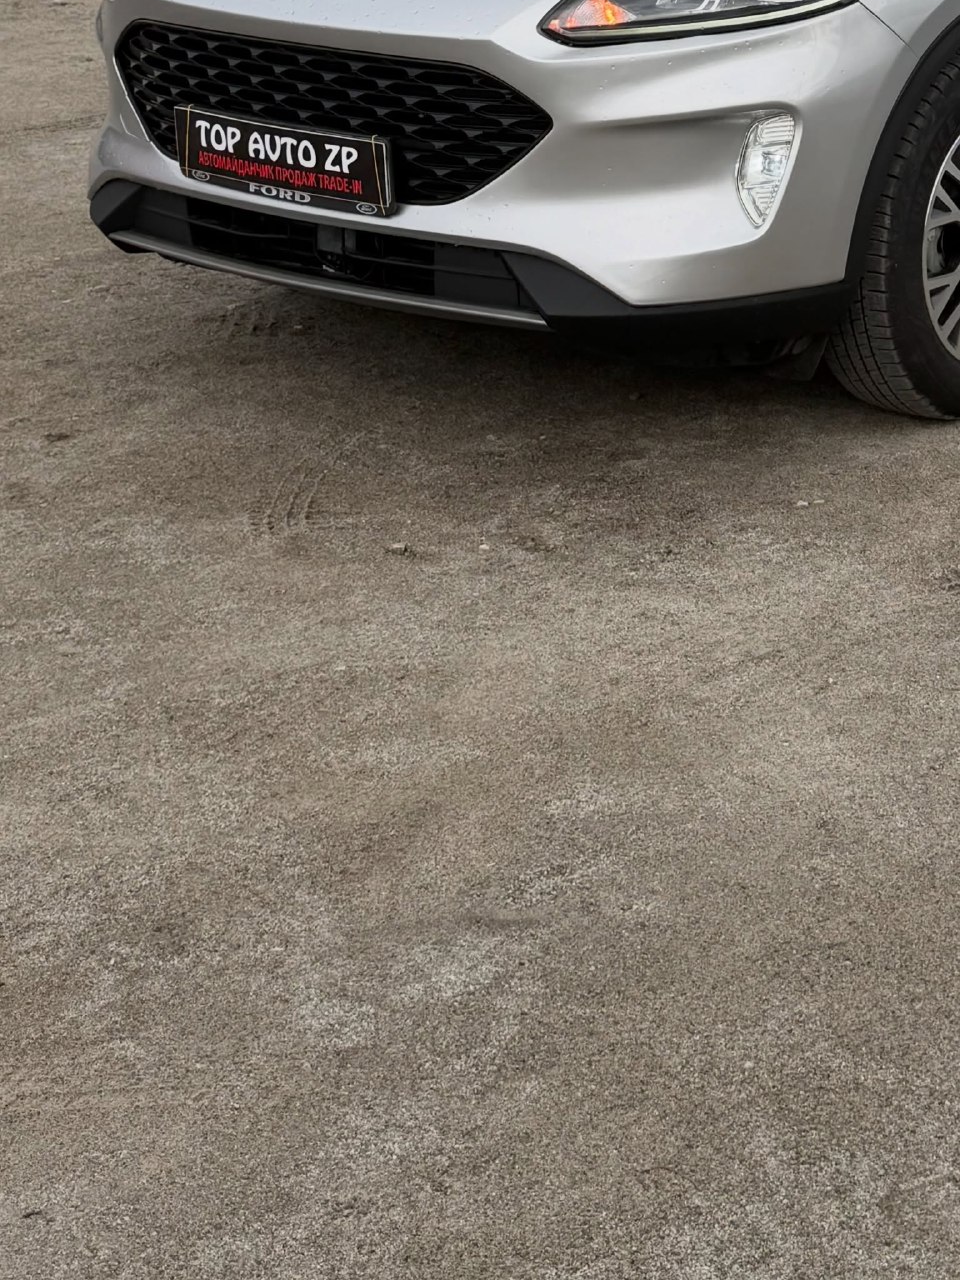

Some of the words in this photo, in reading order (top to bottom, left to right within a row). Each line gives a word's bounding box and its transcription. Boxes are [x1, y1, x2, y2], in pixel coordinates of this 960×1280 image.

[195, 120, 241, 153] TOP
[324, 143, 358, 174] ZP
[198, 150, 274, 180] АВТОМАЙДАНЧИК
[275, 166, 317, 188] ПРОДАЖ
[317, 174, 363, 195] TRADE-IN
[249, 183, 311, 203] FORD
